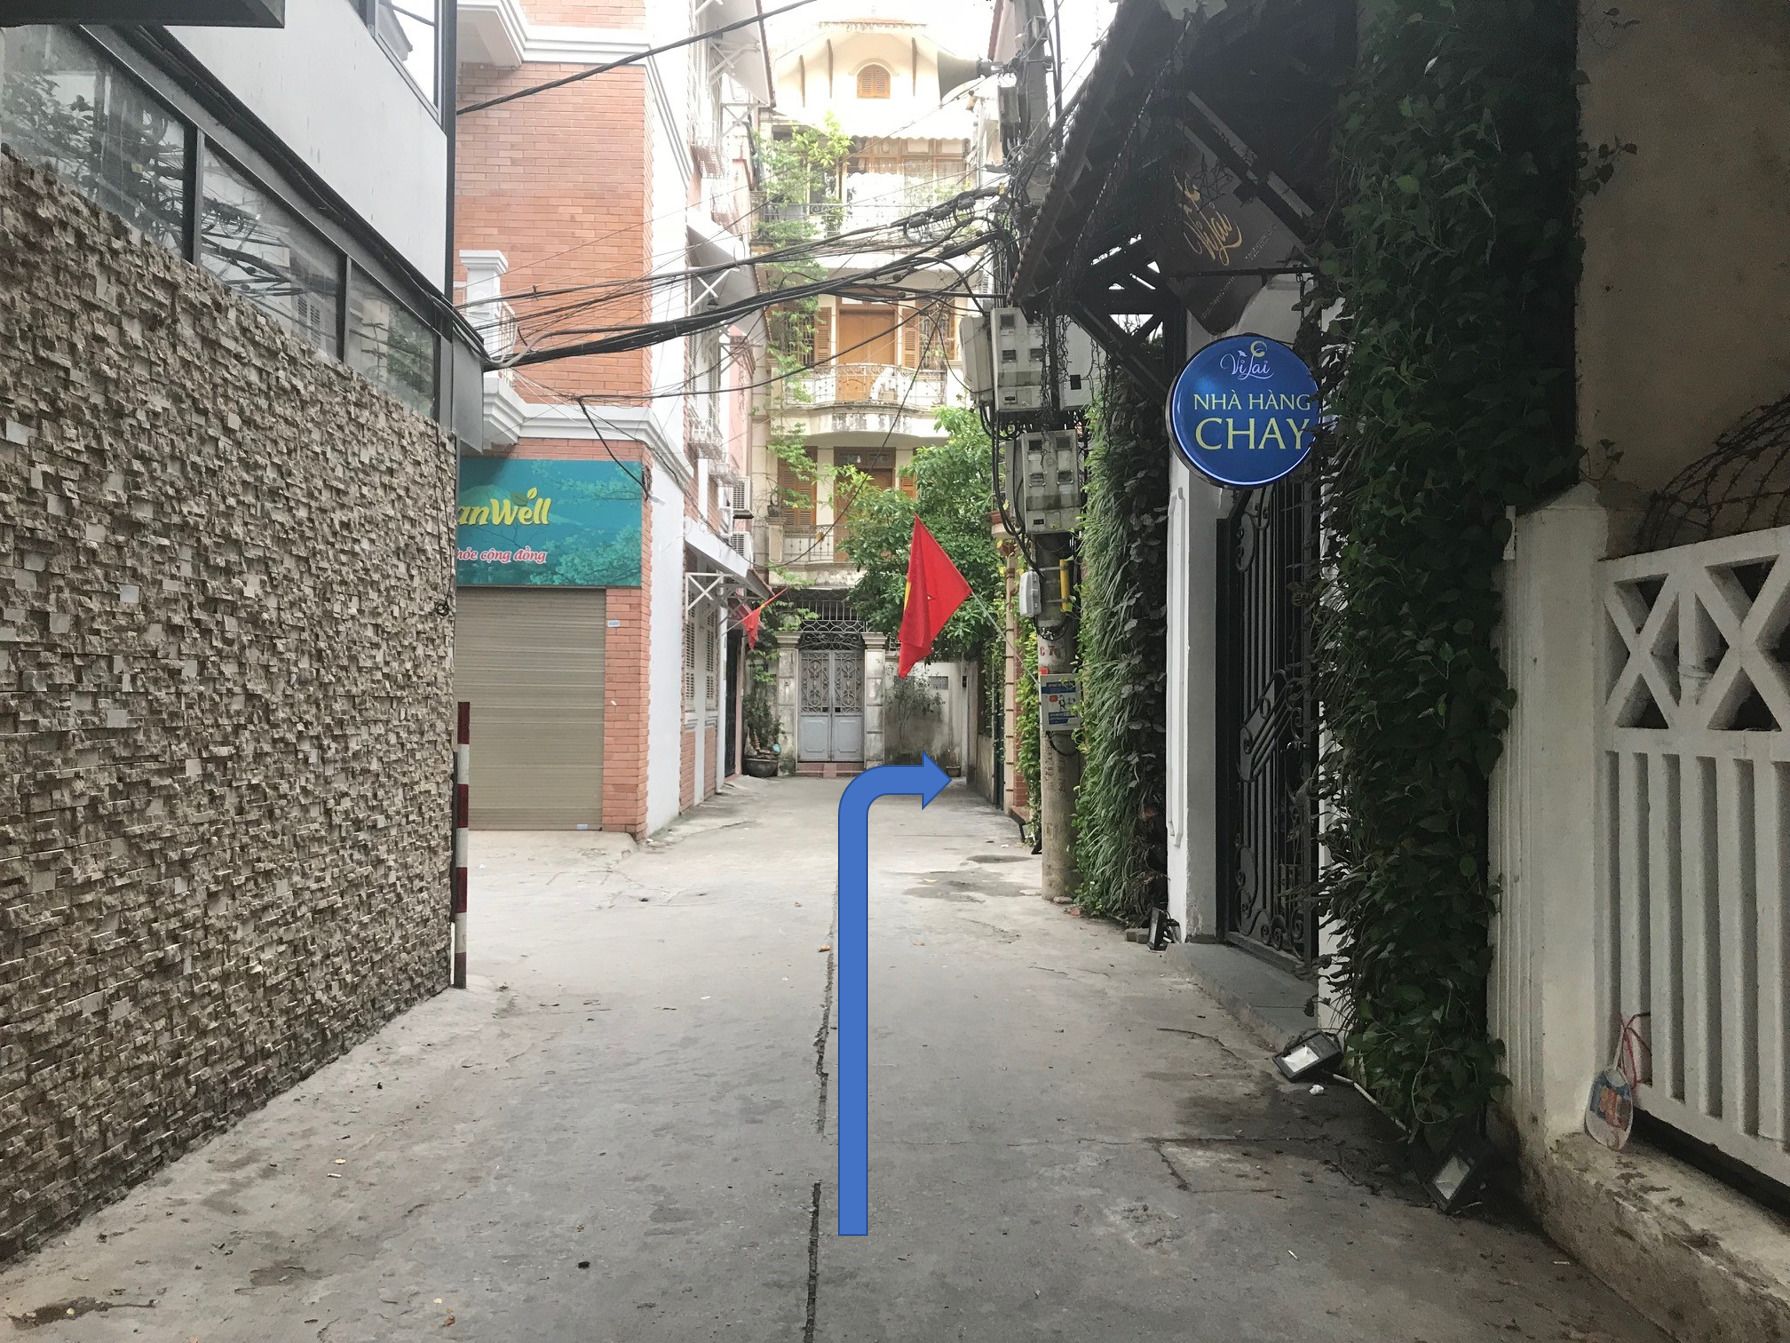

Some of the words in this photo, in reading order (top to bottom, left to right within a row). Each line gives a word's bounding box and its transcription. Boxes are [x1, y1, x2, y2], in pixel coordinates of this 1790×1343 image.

[1194, 389, 1242, 411] NHÀ
[1248, 389, 1311, 411] HÀNG
[1195, 417, 1310, 450] CHAY
[480, 548, 511, 563] cộng
[513, 545, 547, 564] đồng
